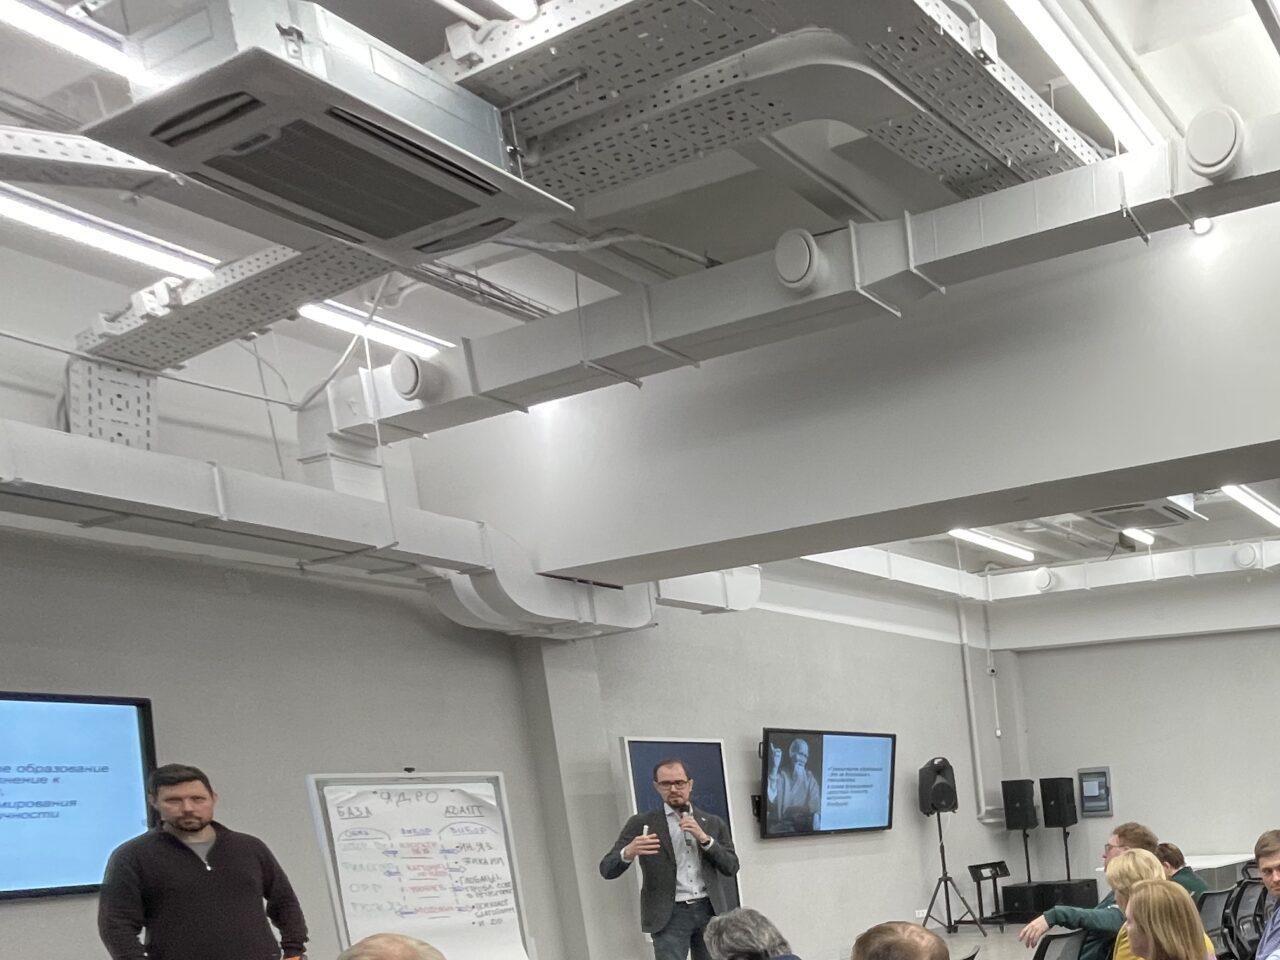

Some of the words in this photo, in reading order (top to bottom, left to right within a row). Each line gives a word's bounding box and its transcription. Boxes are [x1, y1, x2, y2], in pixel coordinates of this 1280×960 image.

[16, 764, 110, 774] образование
[379, 790, 440, 808] ЯДРО
[336, 805, 374, 819] БАЗА
